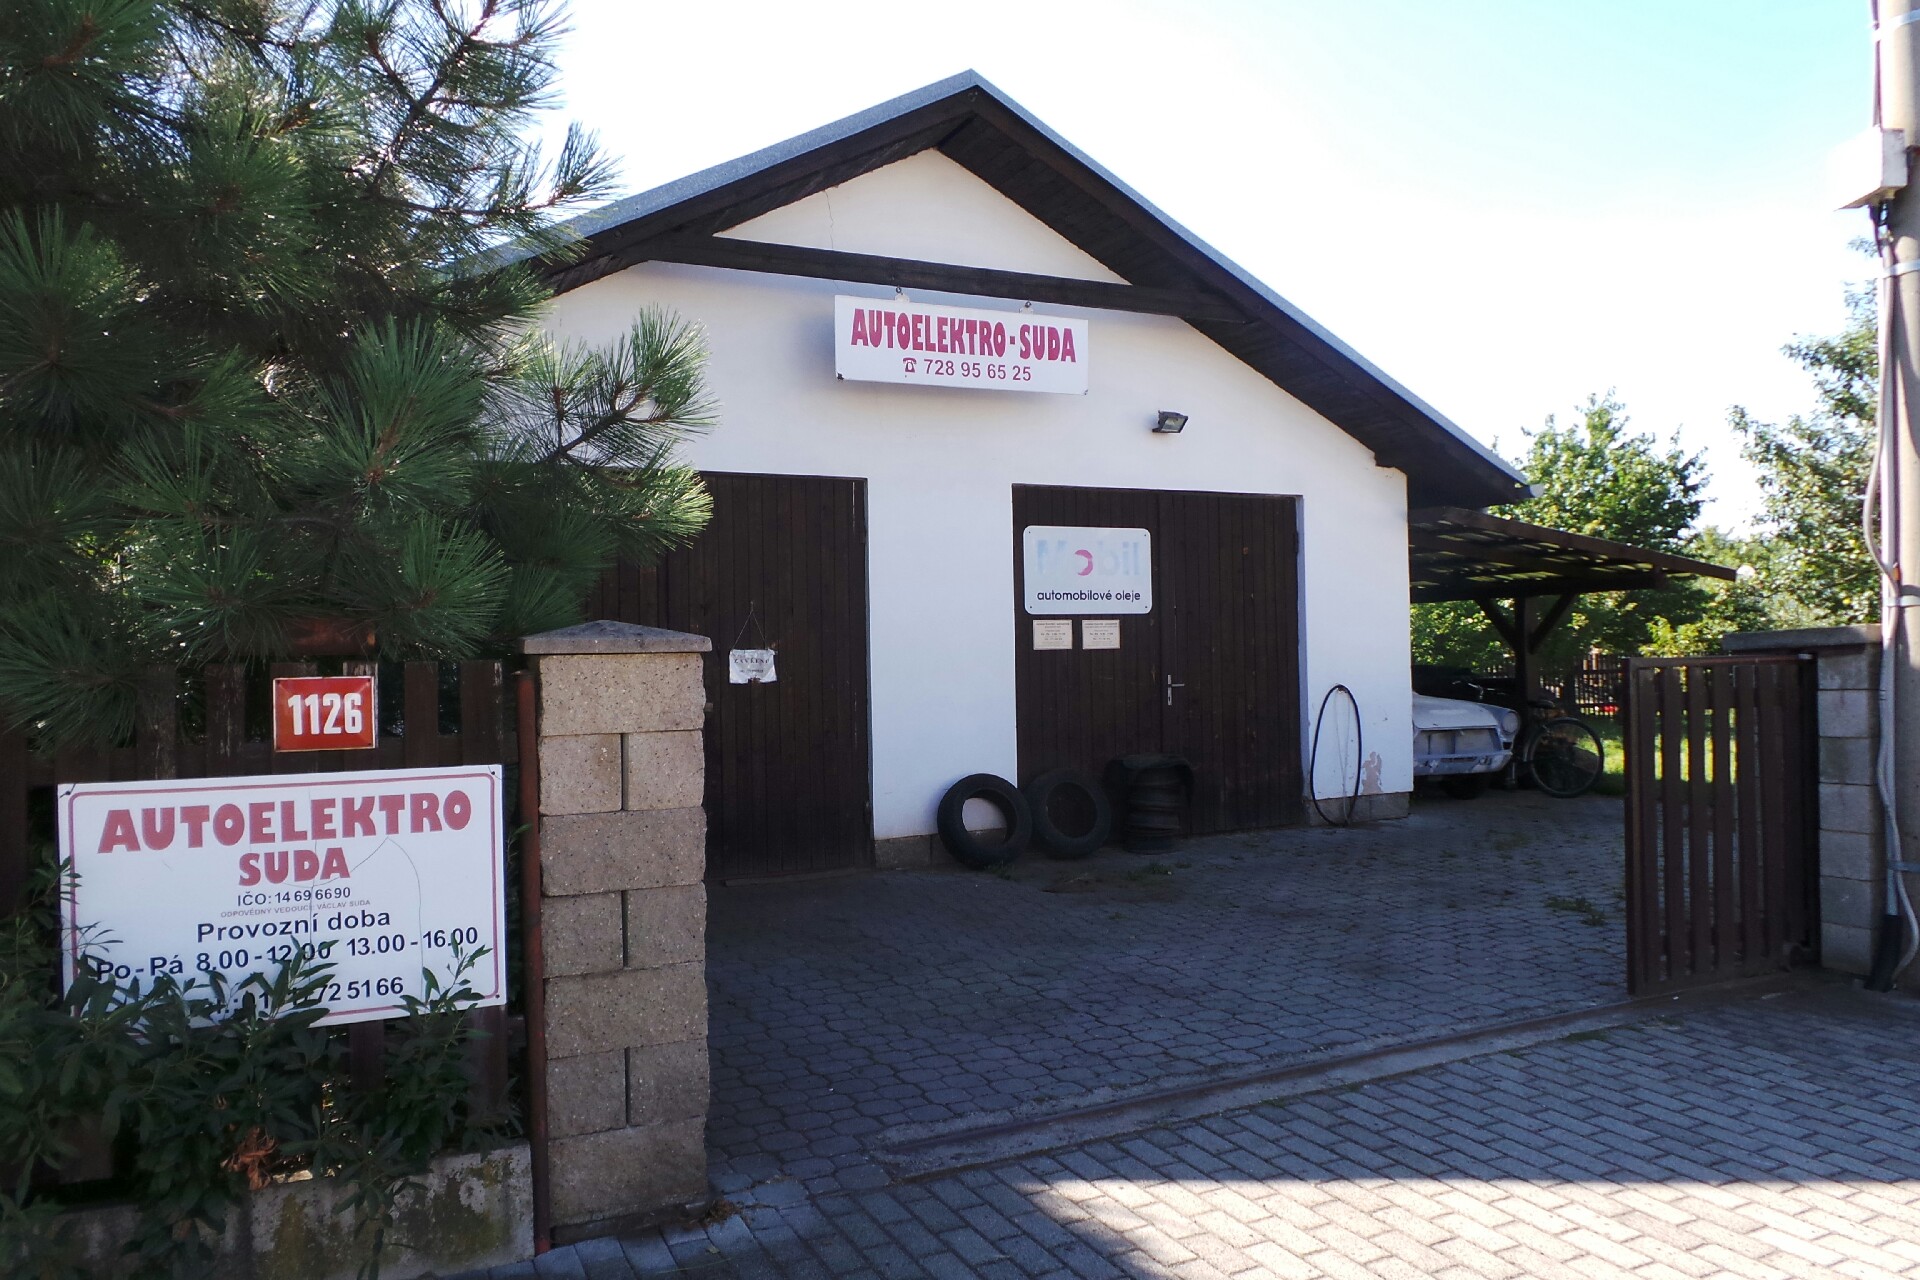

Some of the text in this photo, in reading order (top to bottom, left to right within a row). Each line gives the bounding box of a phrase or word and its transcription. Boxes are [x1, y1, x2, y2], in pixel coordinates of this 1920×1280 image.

[924, 359, 1032, 381] 728 95 65 25
[1037, 590, 1141, 603] automobilové oleje
[287, 692, 362, 736] 1126
[98, 789, 472, 854] AUTOELEKTRO
[239, 847, 350, 886] SUDA
[237, 891, 272, 906] IČO:
[350, 899, 371, 907] SUDA
[197, 910, 390, 942] Provozní doba
